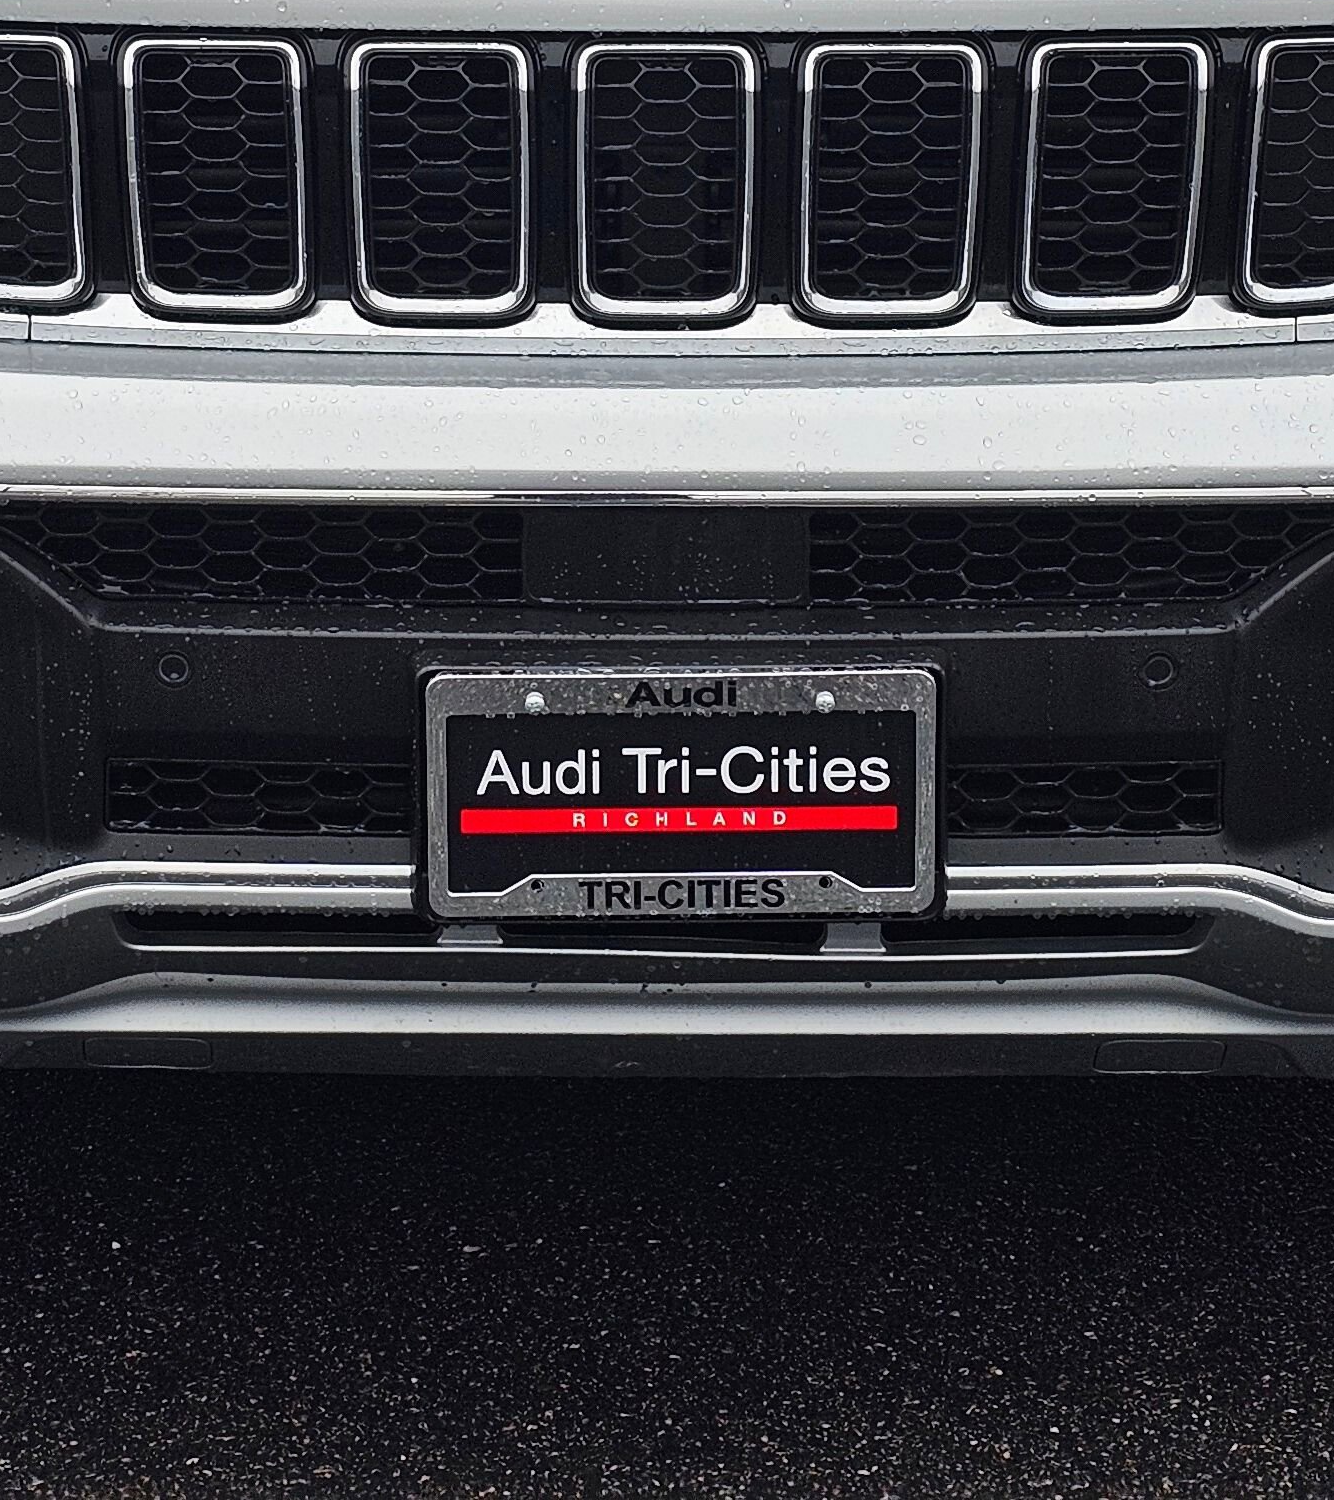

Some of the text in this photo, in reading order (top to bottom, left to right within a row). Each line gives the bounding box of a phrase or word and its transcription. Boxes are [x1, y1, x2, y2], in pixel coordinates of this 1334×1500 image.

[625, 680, 738, 708] Audi
[476, 746, 891, 795] Audi Tri-Cities
[572, 811, 787, 828] RICHLAND
[578, 879, 787, 911] TRI-CITIES
